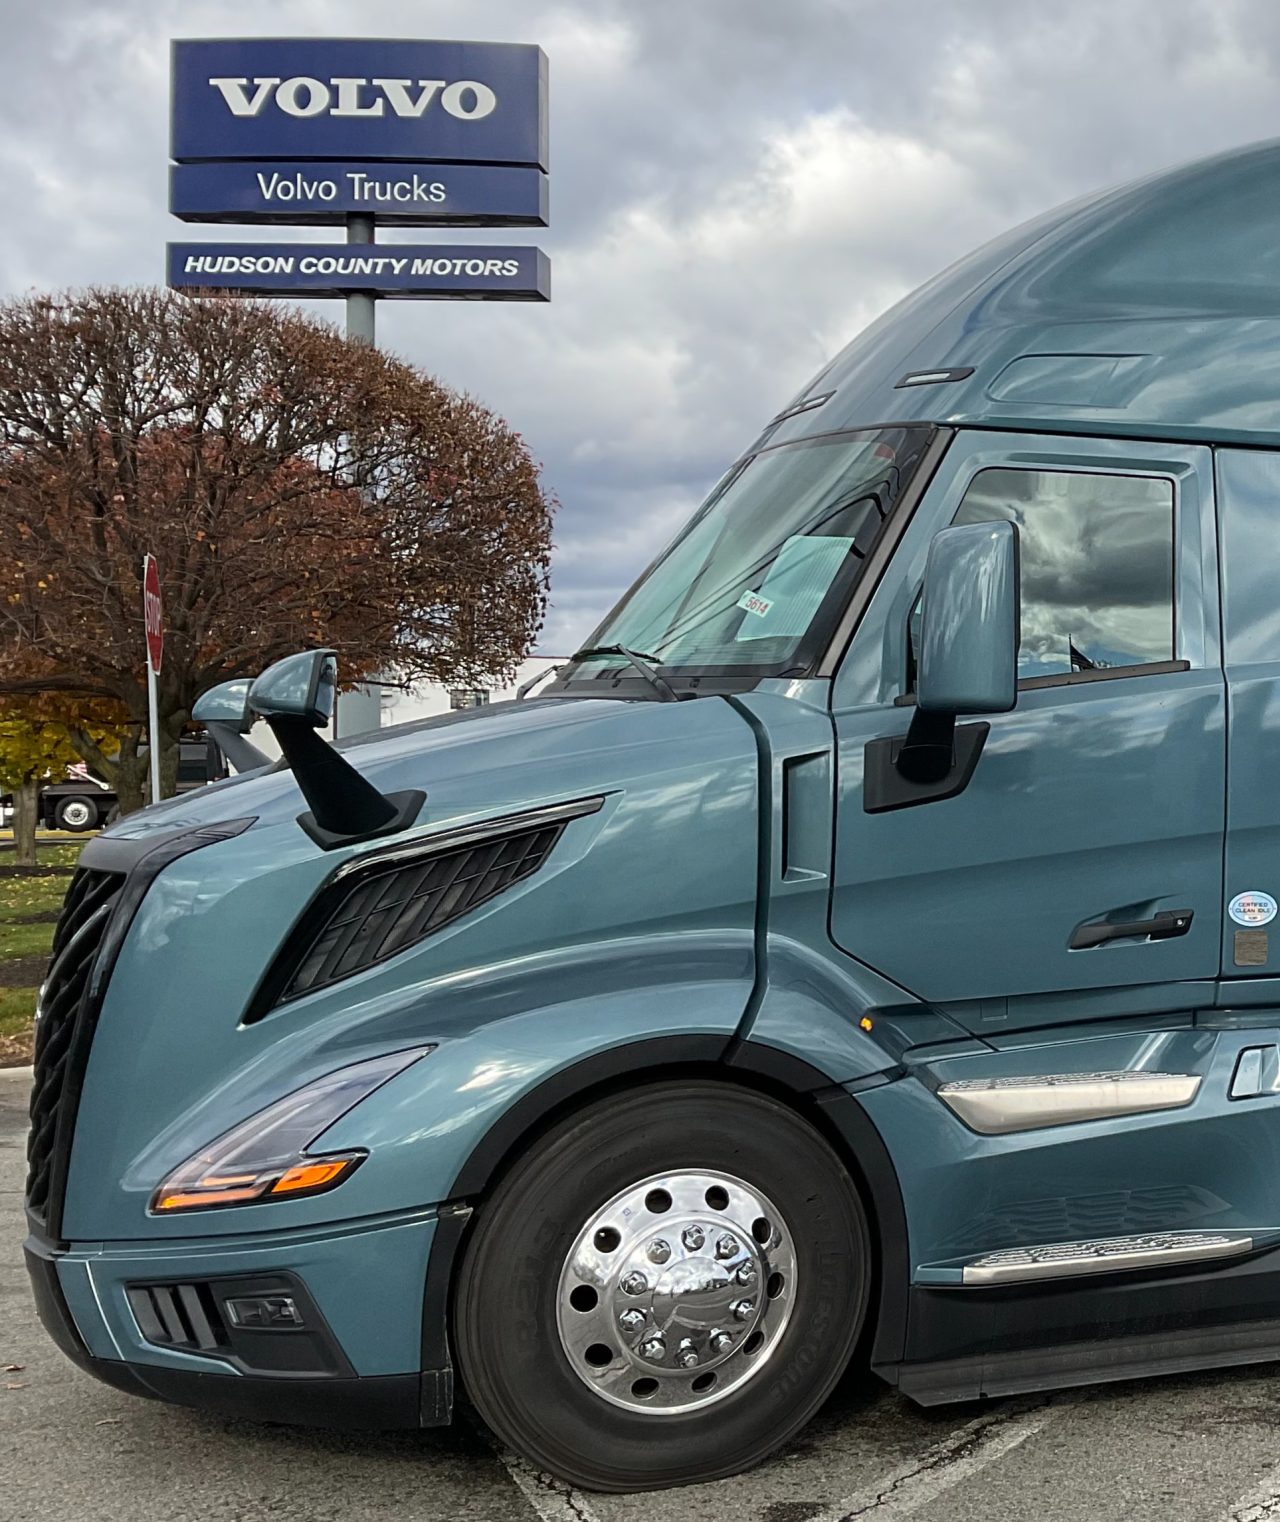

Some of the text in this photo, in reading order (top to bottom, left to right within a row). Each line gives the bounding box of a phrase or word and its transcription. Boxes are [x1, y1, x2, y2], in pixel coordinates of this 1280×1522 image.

[209, 76, 496, 120] VOLVO
[257, 172, 447, 202] Volvo Trucks
[184, 255, 519, 277] HUDSON COUNTY MOTORS
[146, 590, 160, 637] STOP
